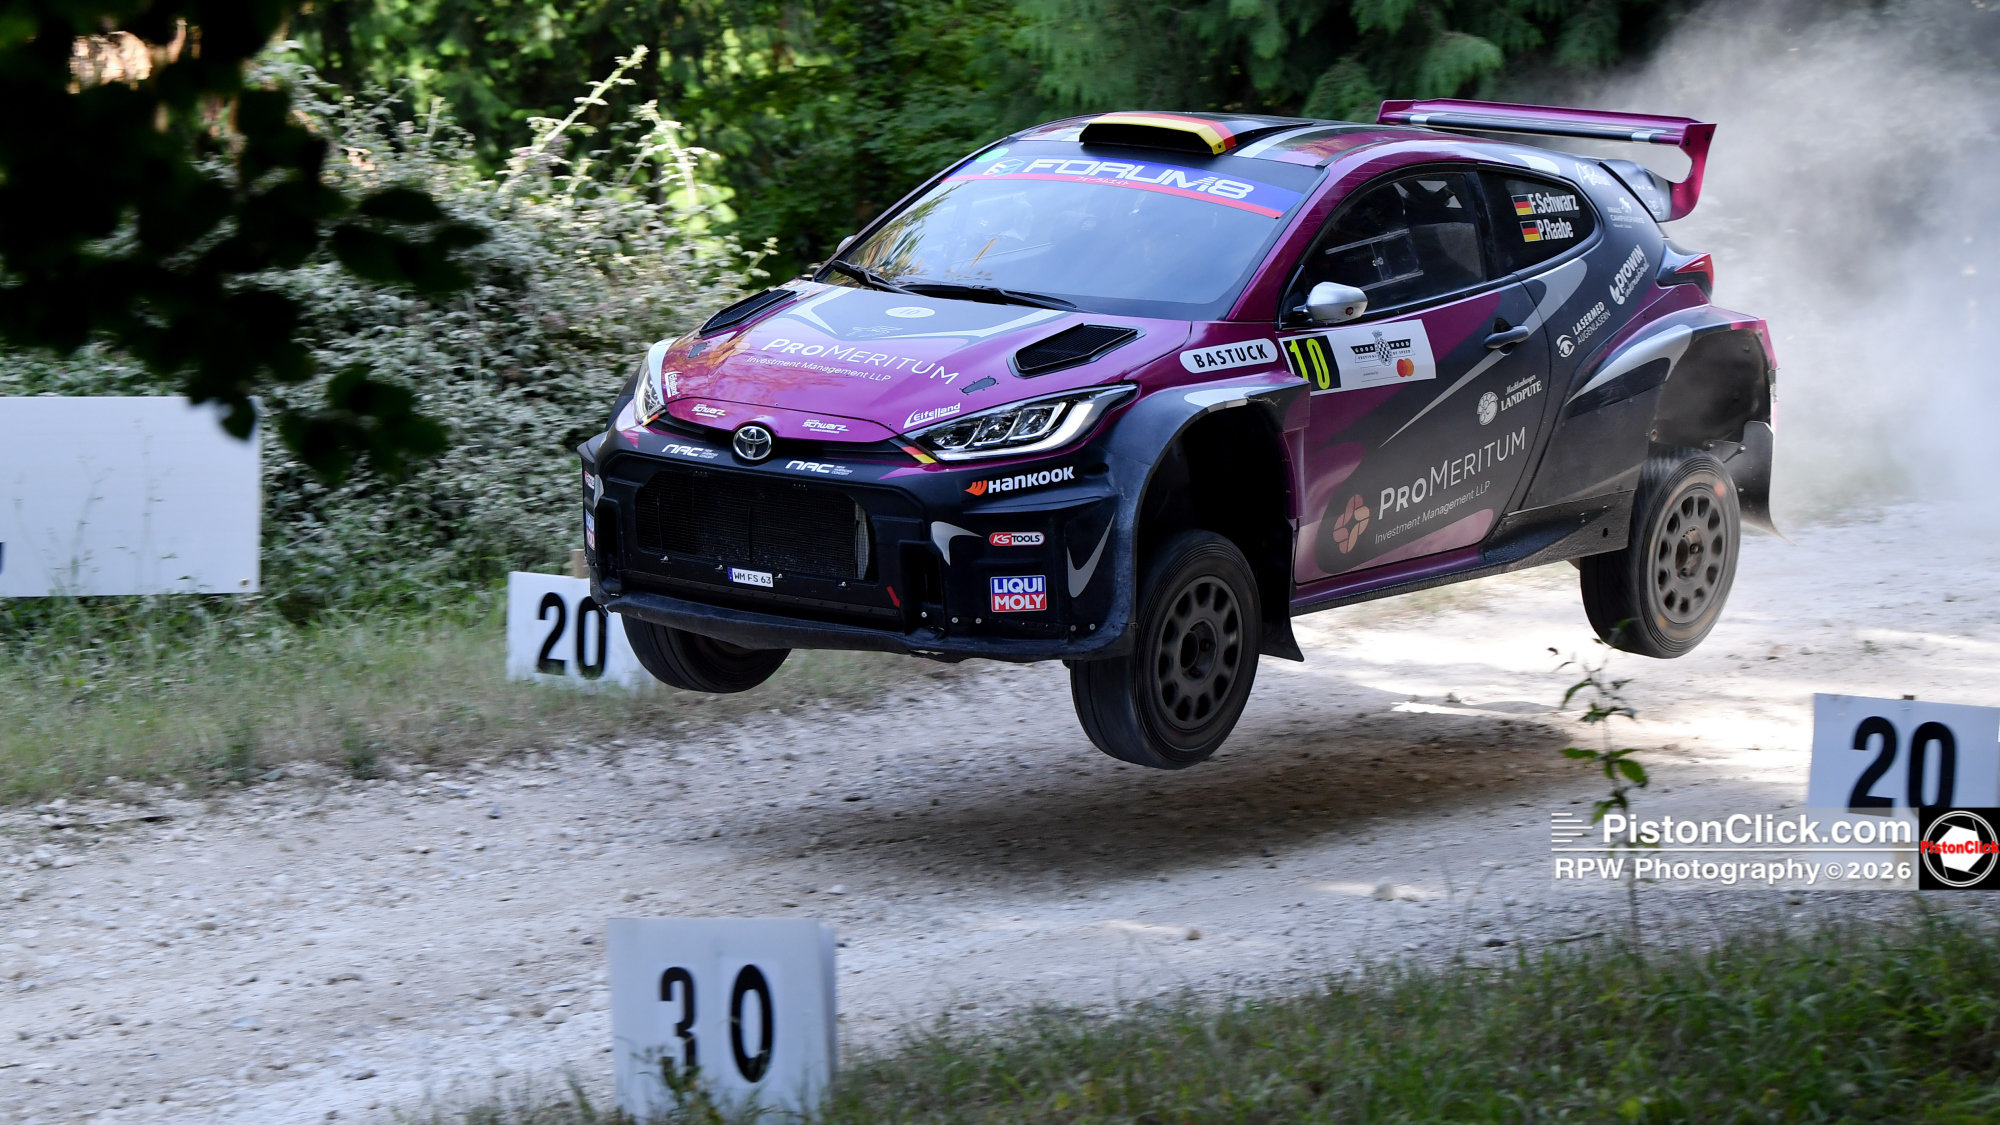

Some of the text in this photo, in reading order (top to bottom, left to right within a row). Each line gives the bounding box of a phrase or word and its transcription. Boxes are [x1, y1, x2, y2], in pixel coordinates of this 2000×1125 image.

[1022, 158, 1254, 199] FORUM8
[1529, 191, 1579, 214] F.Schwarz
[1537, 217, 1574, 240] P.Raabe
[1572, 301, 1605, 335] LASERMED
[1577, 310, 1611, 345] AUGENLASERN
[746, 355, 892, 382] Investment Management LLP
[1193, 344, 1269, 369] BASTUCK
[1289, 338, 1331, 390] 10
[1501, 380, 1542, 411] LANDPUTE
[1375, 480, 1491, 544] Investment Management LLP
[993, 534, 1041, 545] KS TOOLS
[747, 573, 759, 583] FS
[760, 575, 772, 585] 63
[993, 578, 1043, 593] LIQUI
[994, 595, 1045, 610] MOLY
[537, 592, 608, 680] 20
[1847, 716, 1957, 817] 20
[660, 964, 774, 1086] 30
